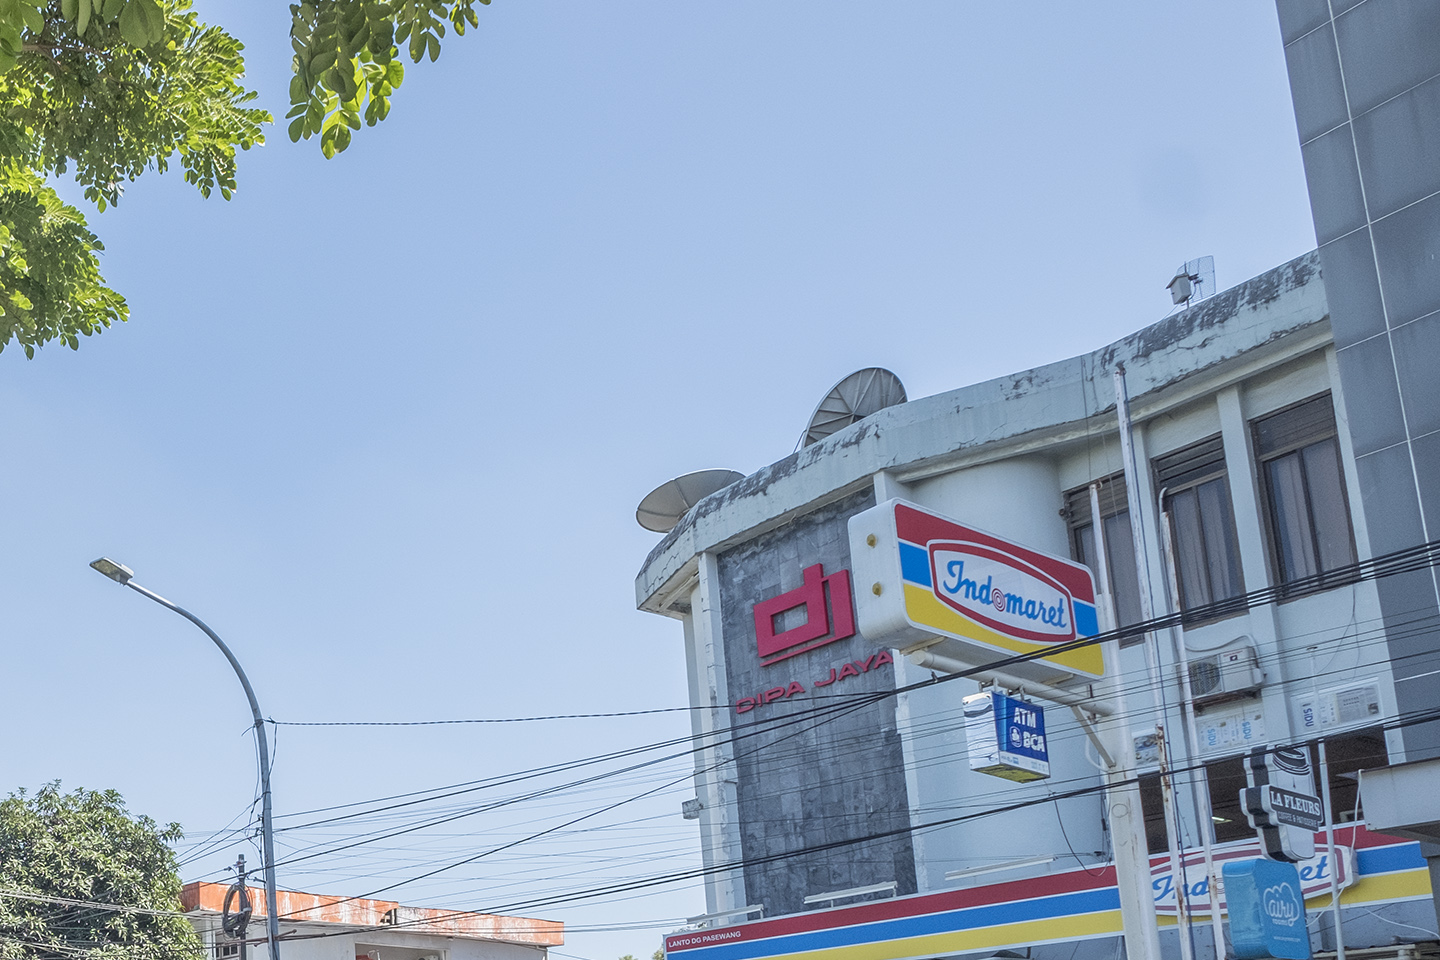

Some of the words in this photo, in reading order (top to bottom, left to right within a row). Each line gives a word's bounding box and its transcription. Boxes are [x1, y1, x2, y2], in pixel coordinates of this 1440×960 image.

[943, 560, 1067, 628] Indomaret
[735, 681, 806, 714] DIPA
[814, 650, 894, 688] JAYA
[1013, 707, 1036, 728] ATM
[1023, 731, 1045, 753] BCA
[1270, 791, 1283, 807] LA
[1283, 794, 1320, 816] FLEURS
[668, 938, 690, 948] LANTO
[702, 931, 741, 942] PASEWANG
